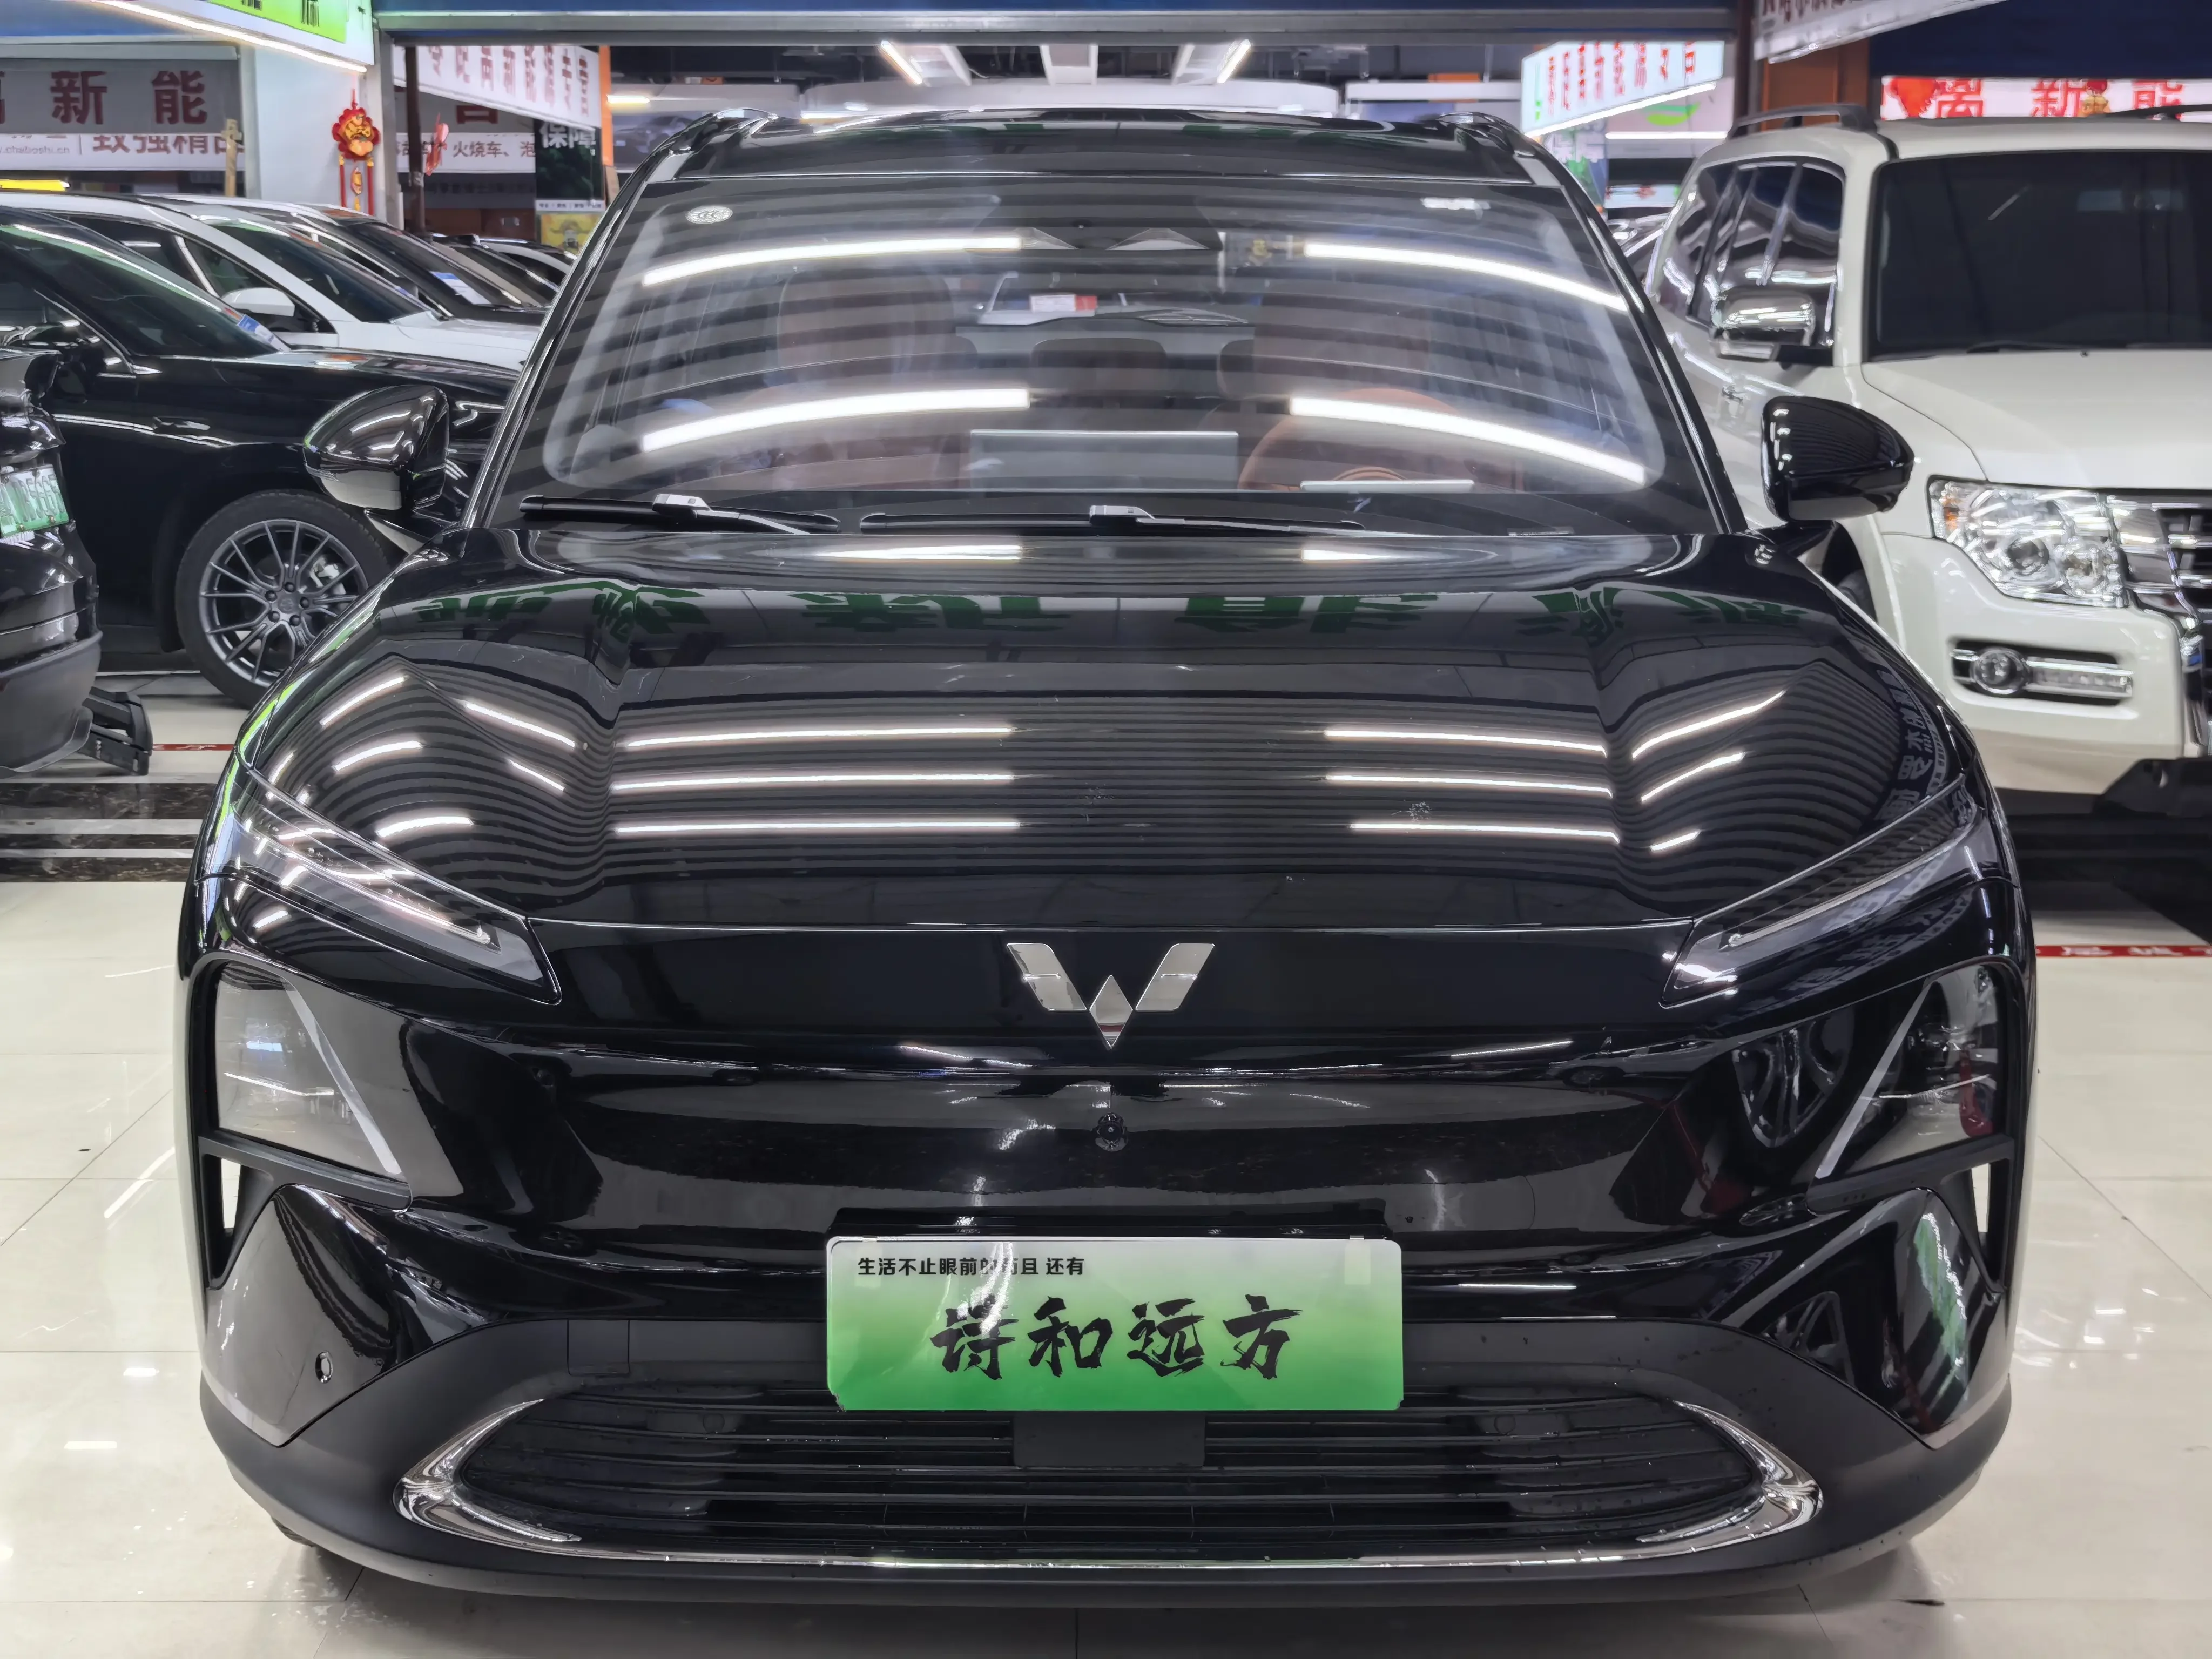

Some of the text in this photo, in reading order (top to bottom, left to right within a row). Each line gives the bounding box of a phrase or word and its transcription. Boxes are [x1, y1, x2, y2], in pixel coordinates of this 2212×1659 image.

[0, 70, 208, 125] 新能
[1045, 1257, 1084, 1276] 还有
[929, 1294, 1303, 1380] 诗和远方
